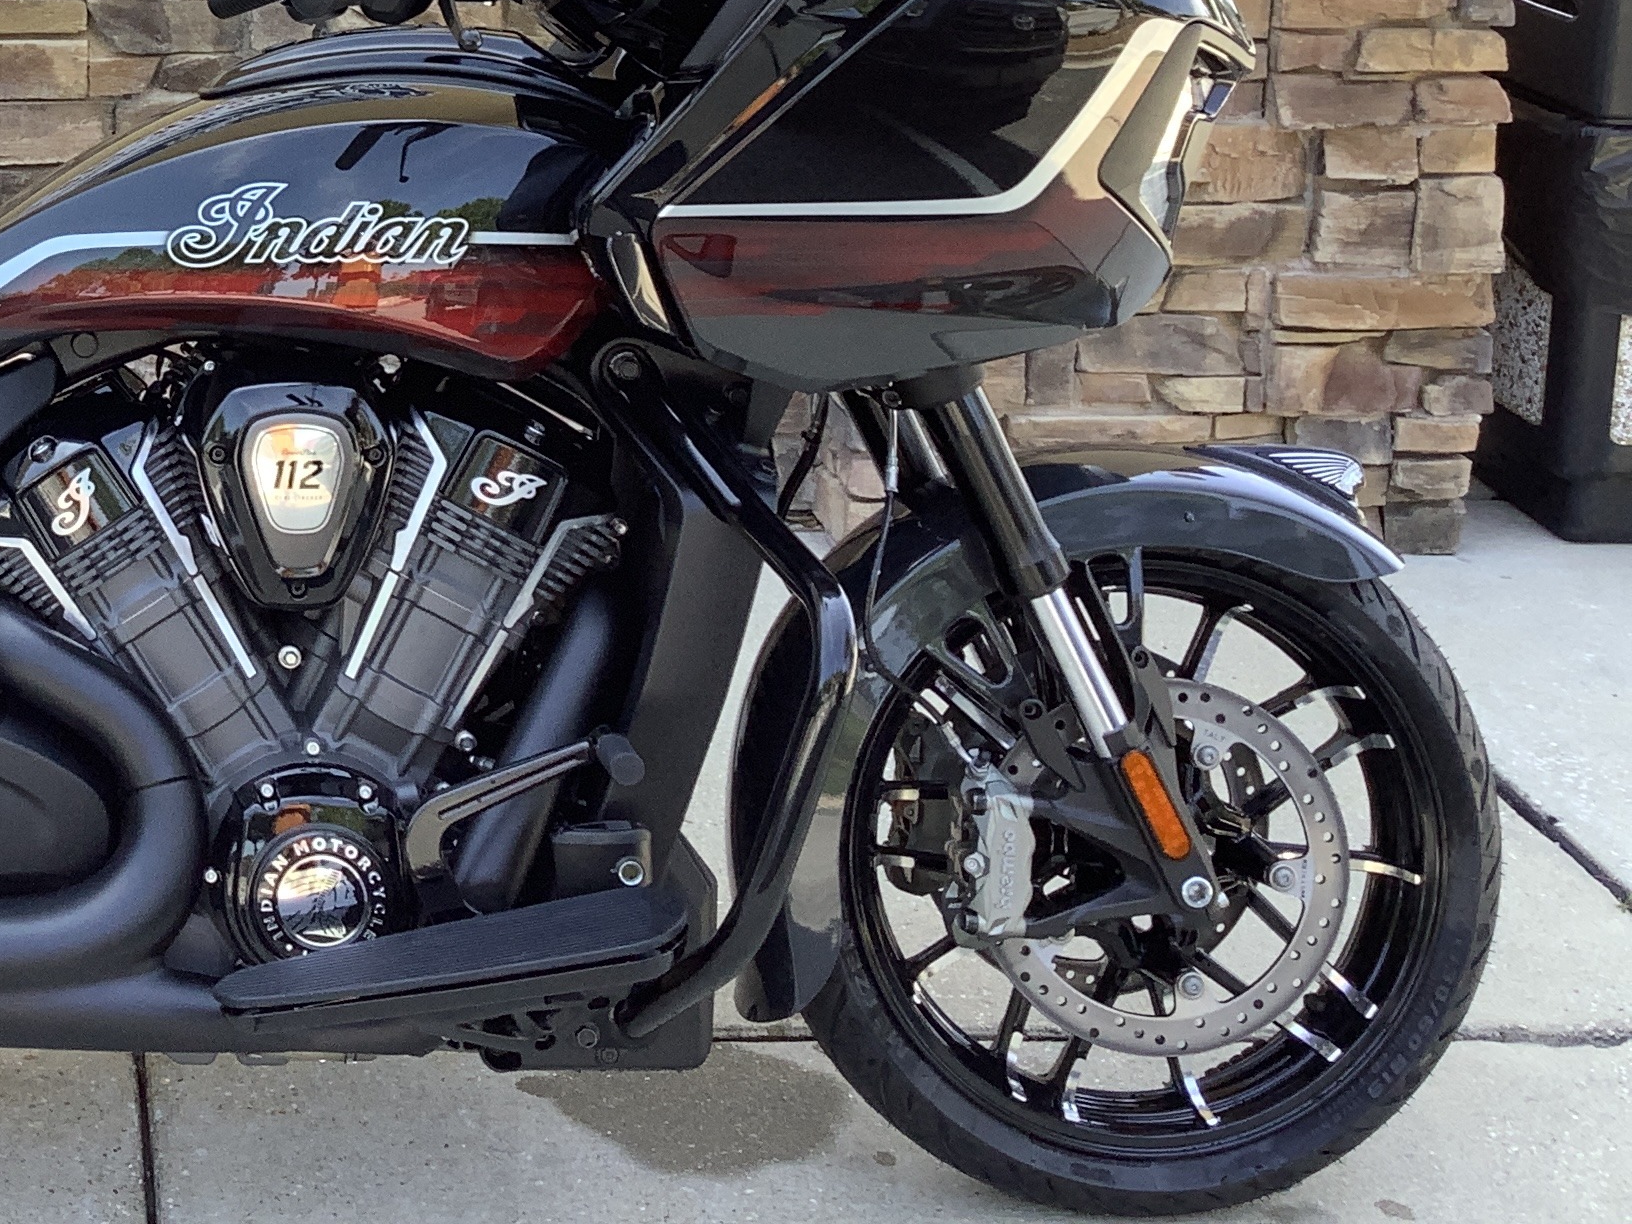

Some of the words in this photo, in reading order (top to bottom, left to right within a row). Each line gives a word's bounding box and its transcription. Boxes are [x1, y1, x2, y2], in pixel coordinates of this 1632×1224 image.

[167, 181, 469, 269] Indian
[273, 460, 324, 490] 112
[261, 854, 289, 941] INDIAN
[293, 837, 386, 940] MOTORCYCLE
